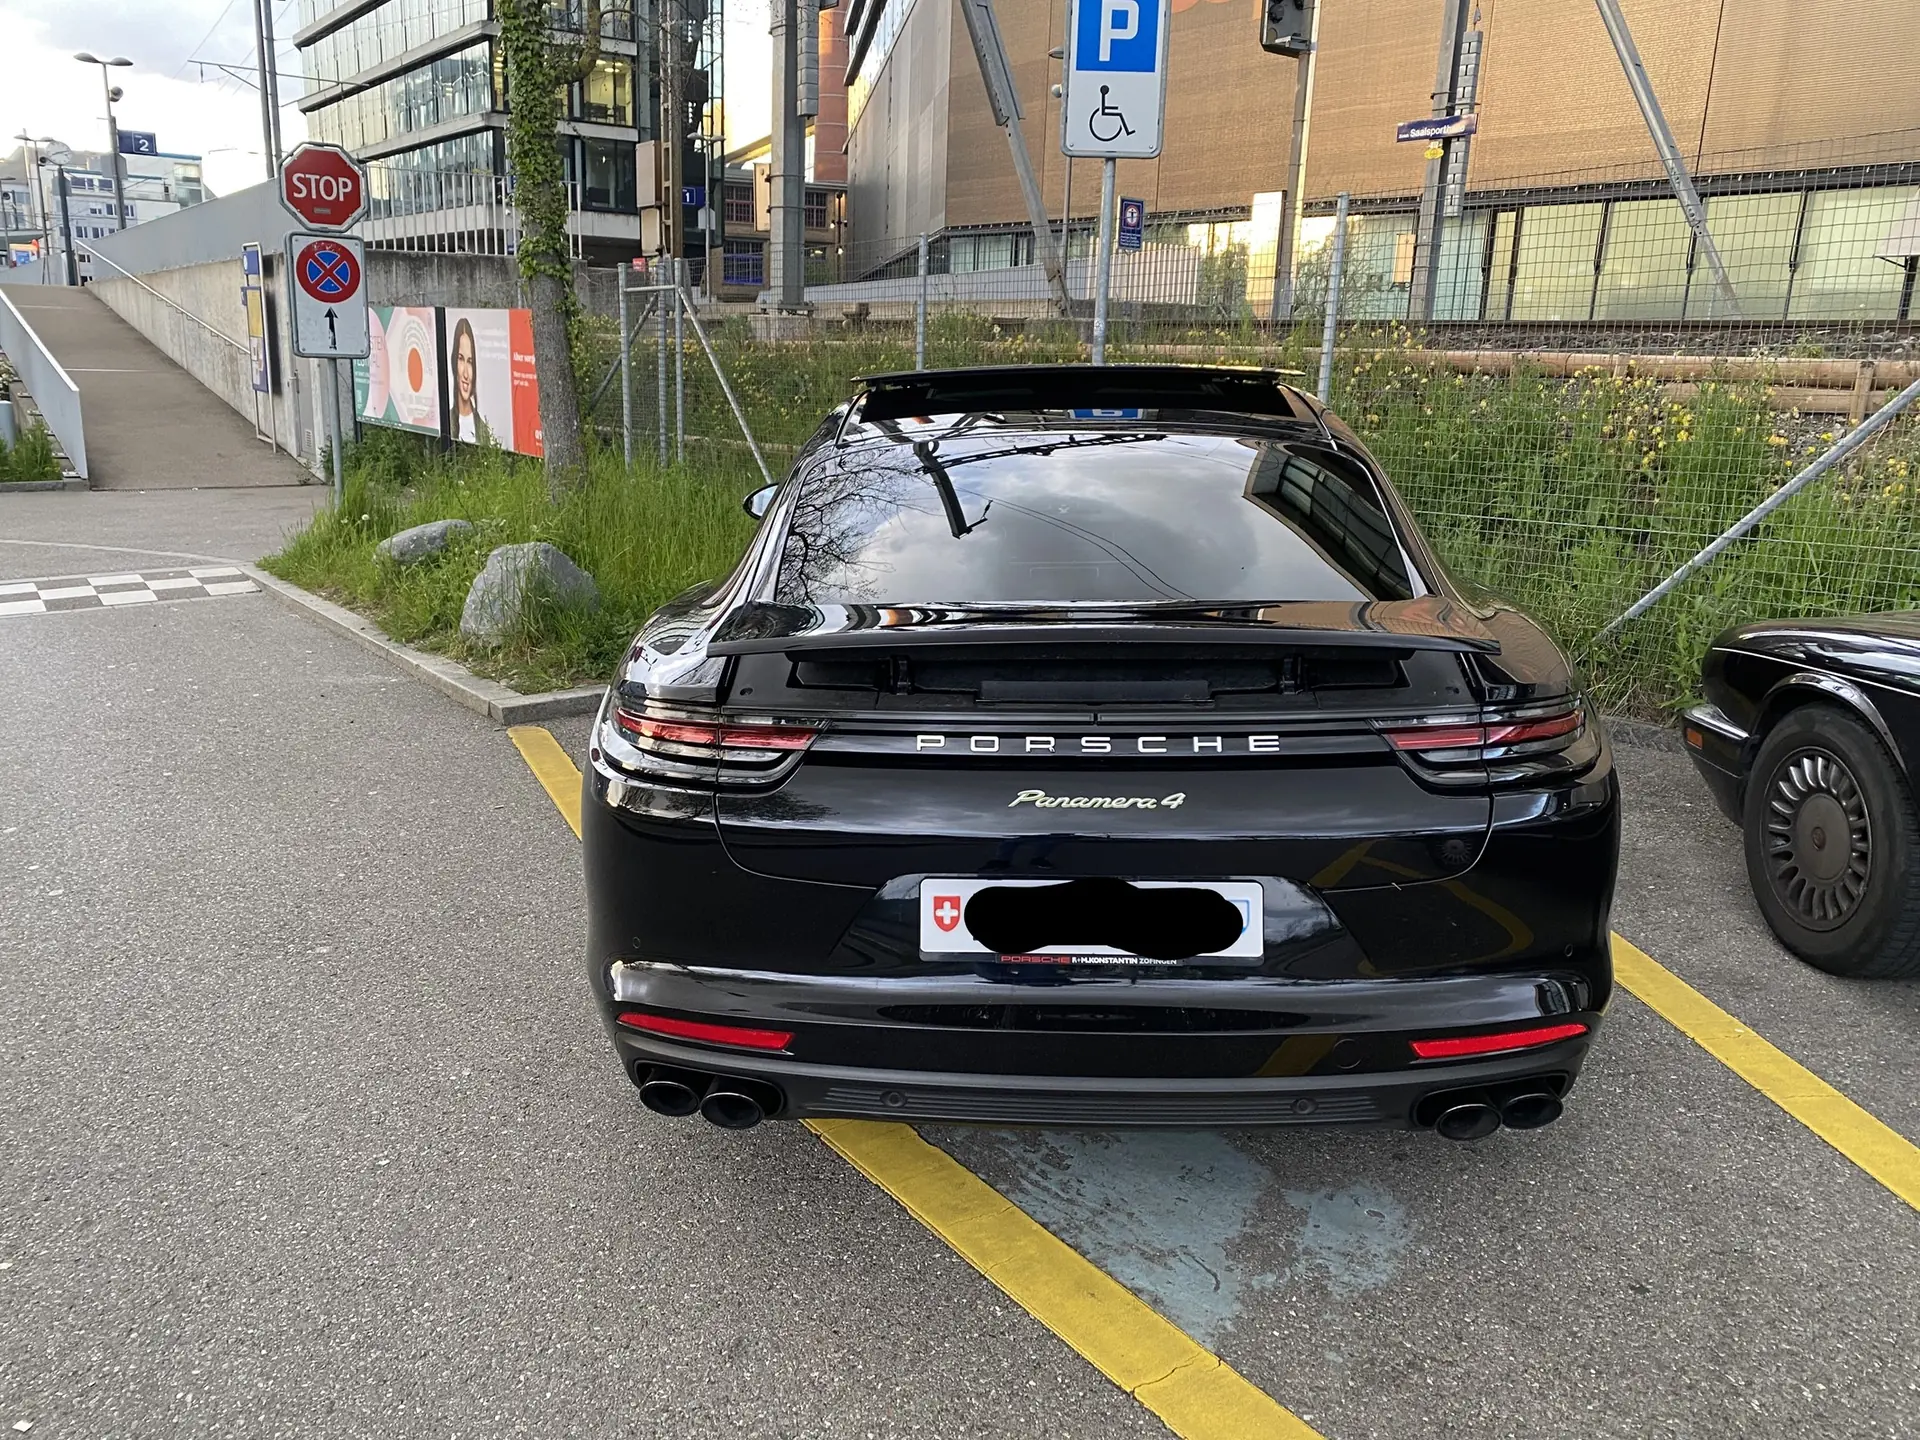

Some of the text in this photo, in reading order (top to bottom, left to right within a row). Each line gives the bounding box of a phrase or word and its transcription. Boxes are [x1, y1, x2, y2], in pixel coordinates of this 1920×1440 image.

[1099, 0, 1139, 61] P
[139, 139, 149, 151] 2
[292, 172, 352, 201] STOP
[686, 192, 690, 202] 1
[916, 735, 1280, 752] PORSCHE
[1008, 789, 1186, 809] Panamera 4
[1001, 955, 1070, 964] PORSCHE
